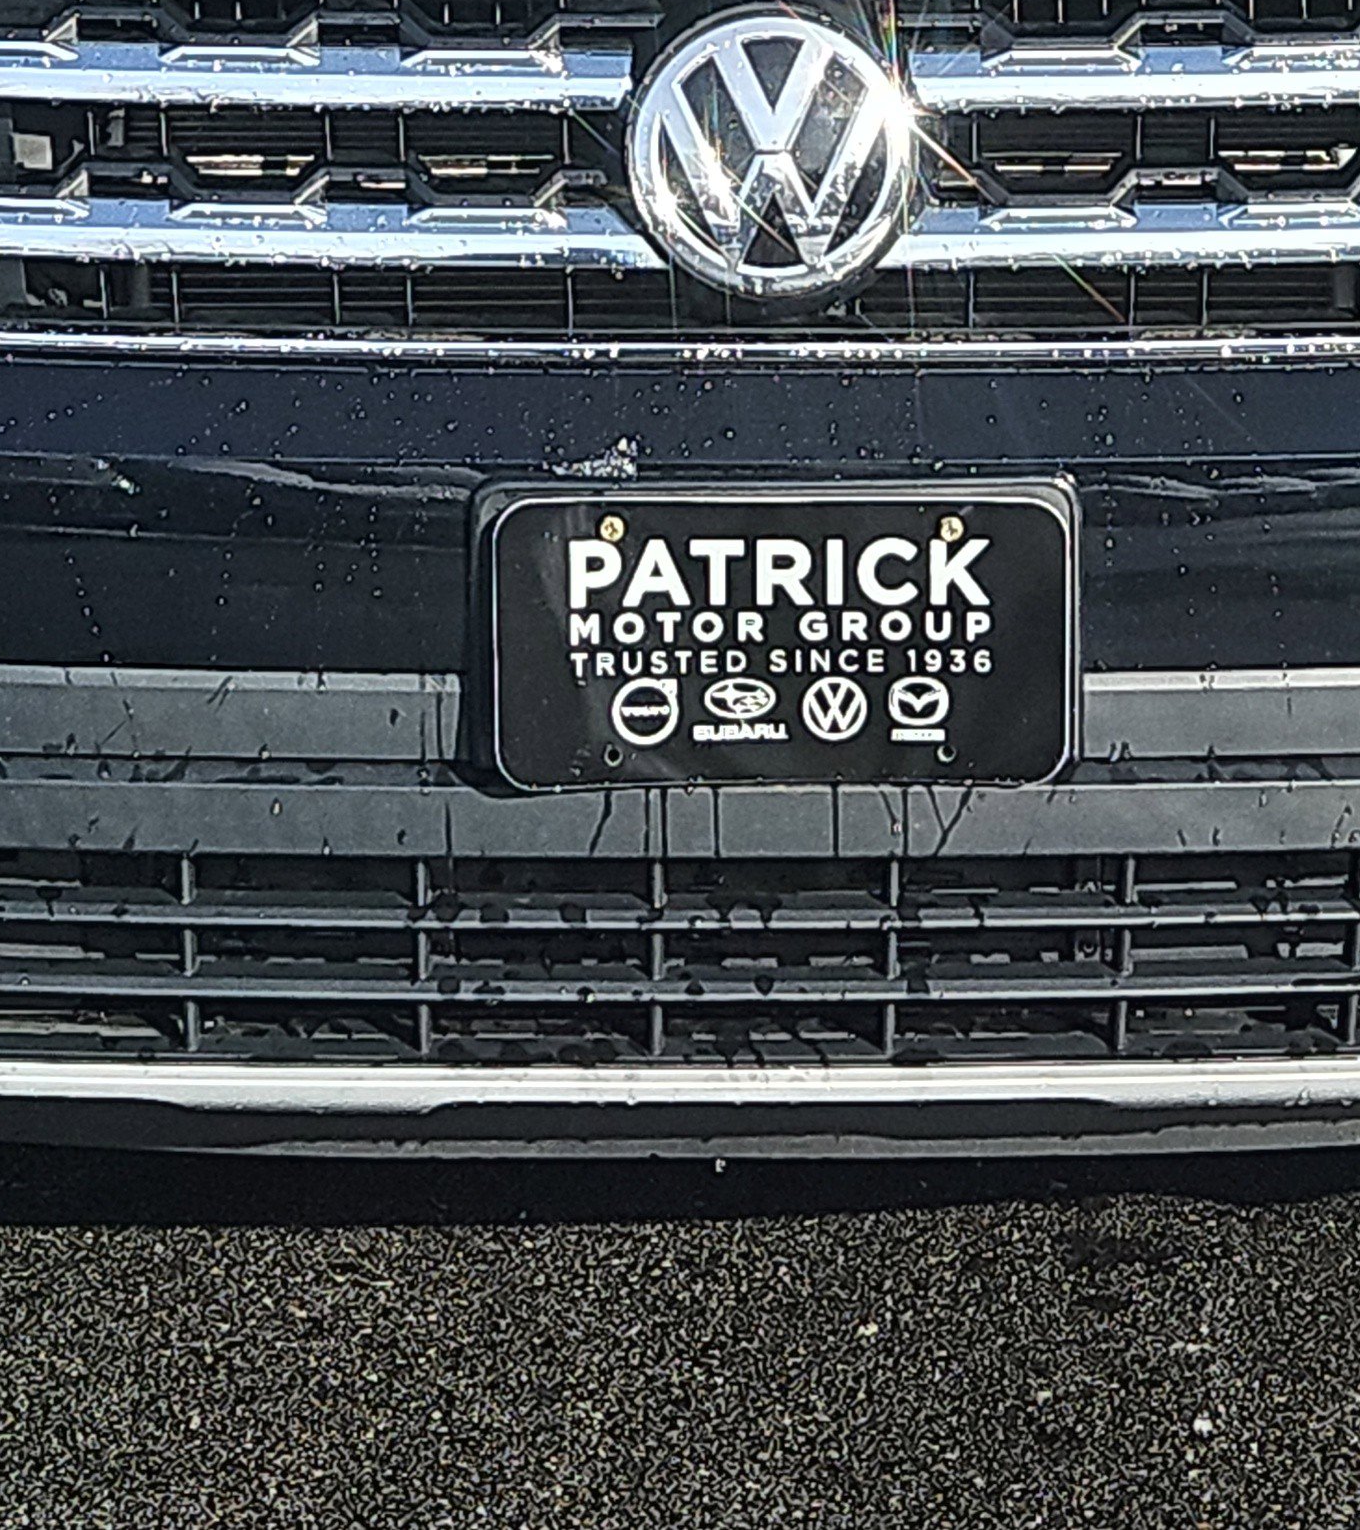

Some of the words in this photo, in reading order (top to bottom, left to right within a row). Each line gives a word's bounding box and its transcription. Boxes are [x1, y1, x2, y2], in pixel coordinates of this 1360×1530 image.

[633, 16, 912, 292] VW
[568, 538, 991, 609] PATRICK
[569, 611, 764, 646] MOTOR
[799, 610, 992, 642] GROUP
[570, 650, 748, 678] TRUSTED
[768, 648, 886, 674] SINCE
[906, 648, 992, 674] 1936
[693, 723, 789, 741] SUBARU
[802, 676, 868, 741] VW
